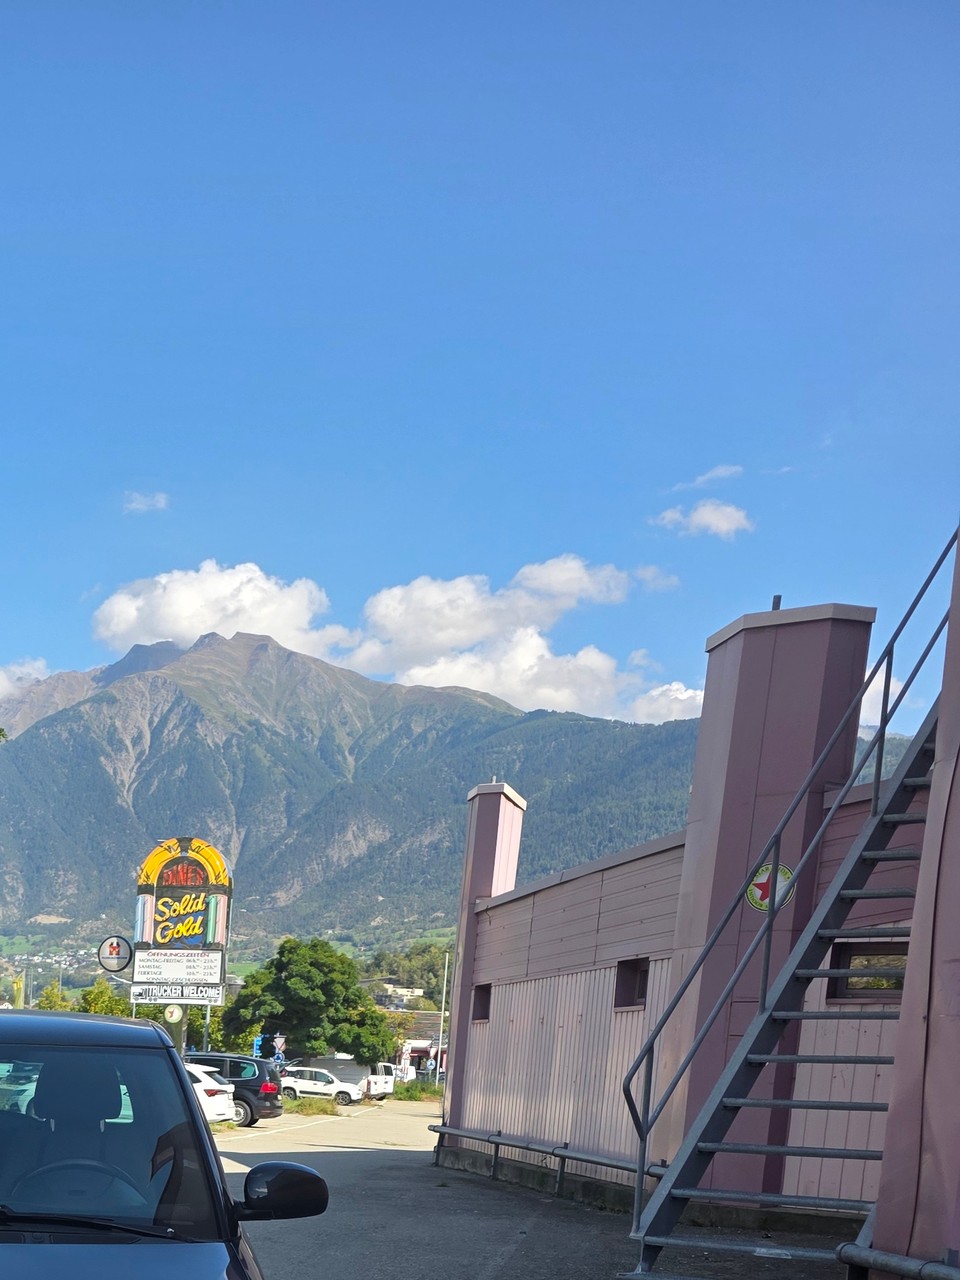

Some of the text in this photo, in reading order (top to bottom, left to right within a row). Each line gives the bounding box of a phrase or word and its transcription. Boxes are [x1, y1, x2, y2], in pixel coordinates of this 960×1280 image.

[162, 863, 204, 886] DINER
[154, 892, 206, 922] Solid
[156, 916, 204, 944] Gold
[148, 986, 220, 998] TRUCKER WELCOME
